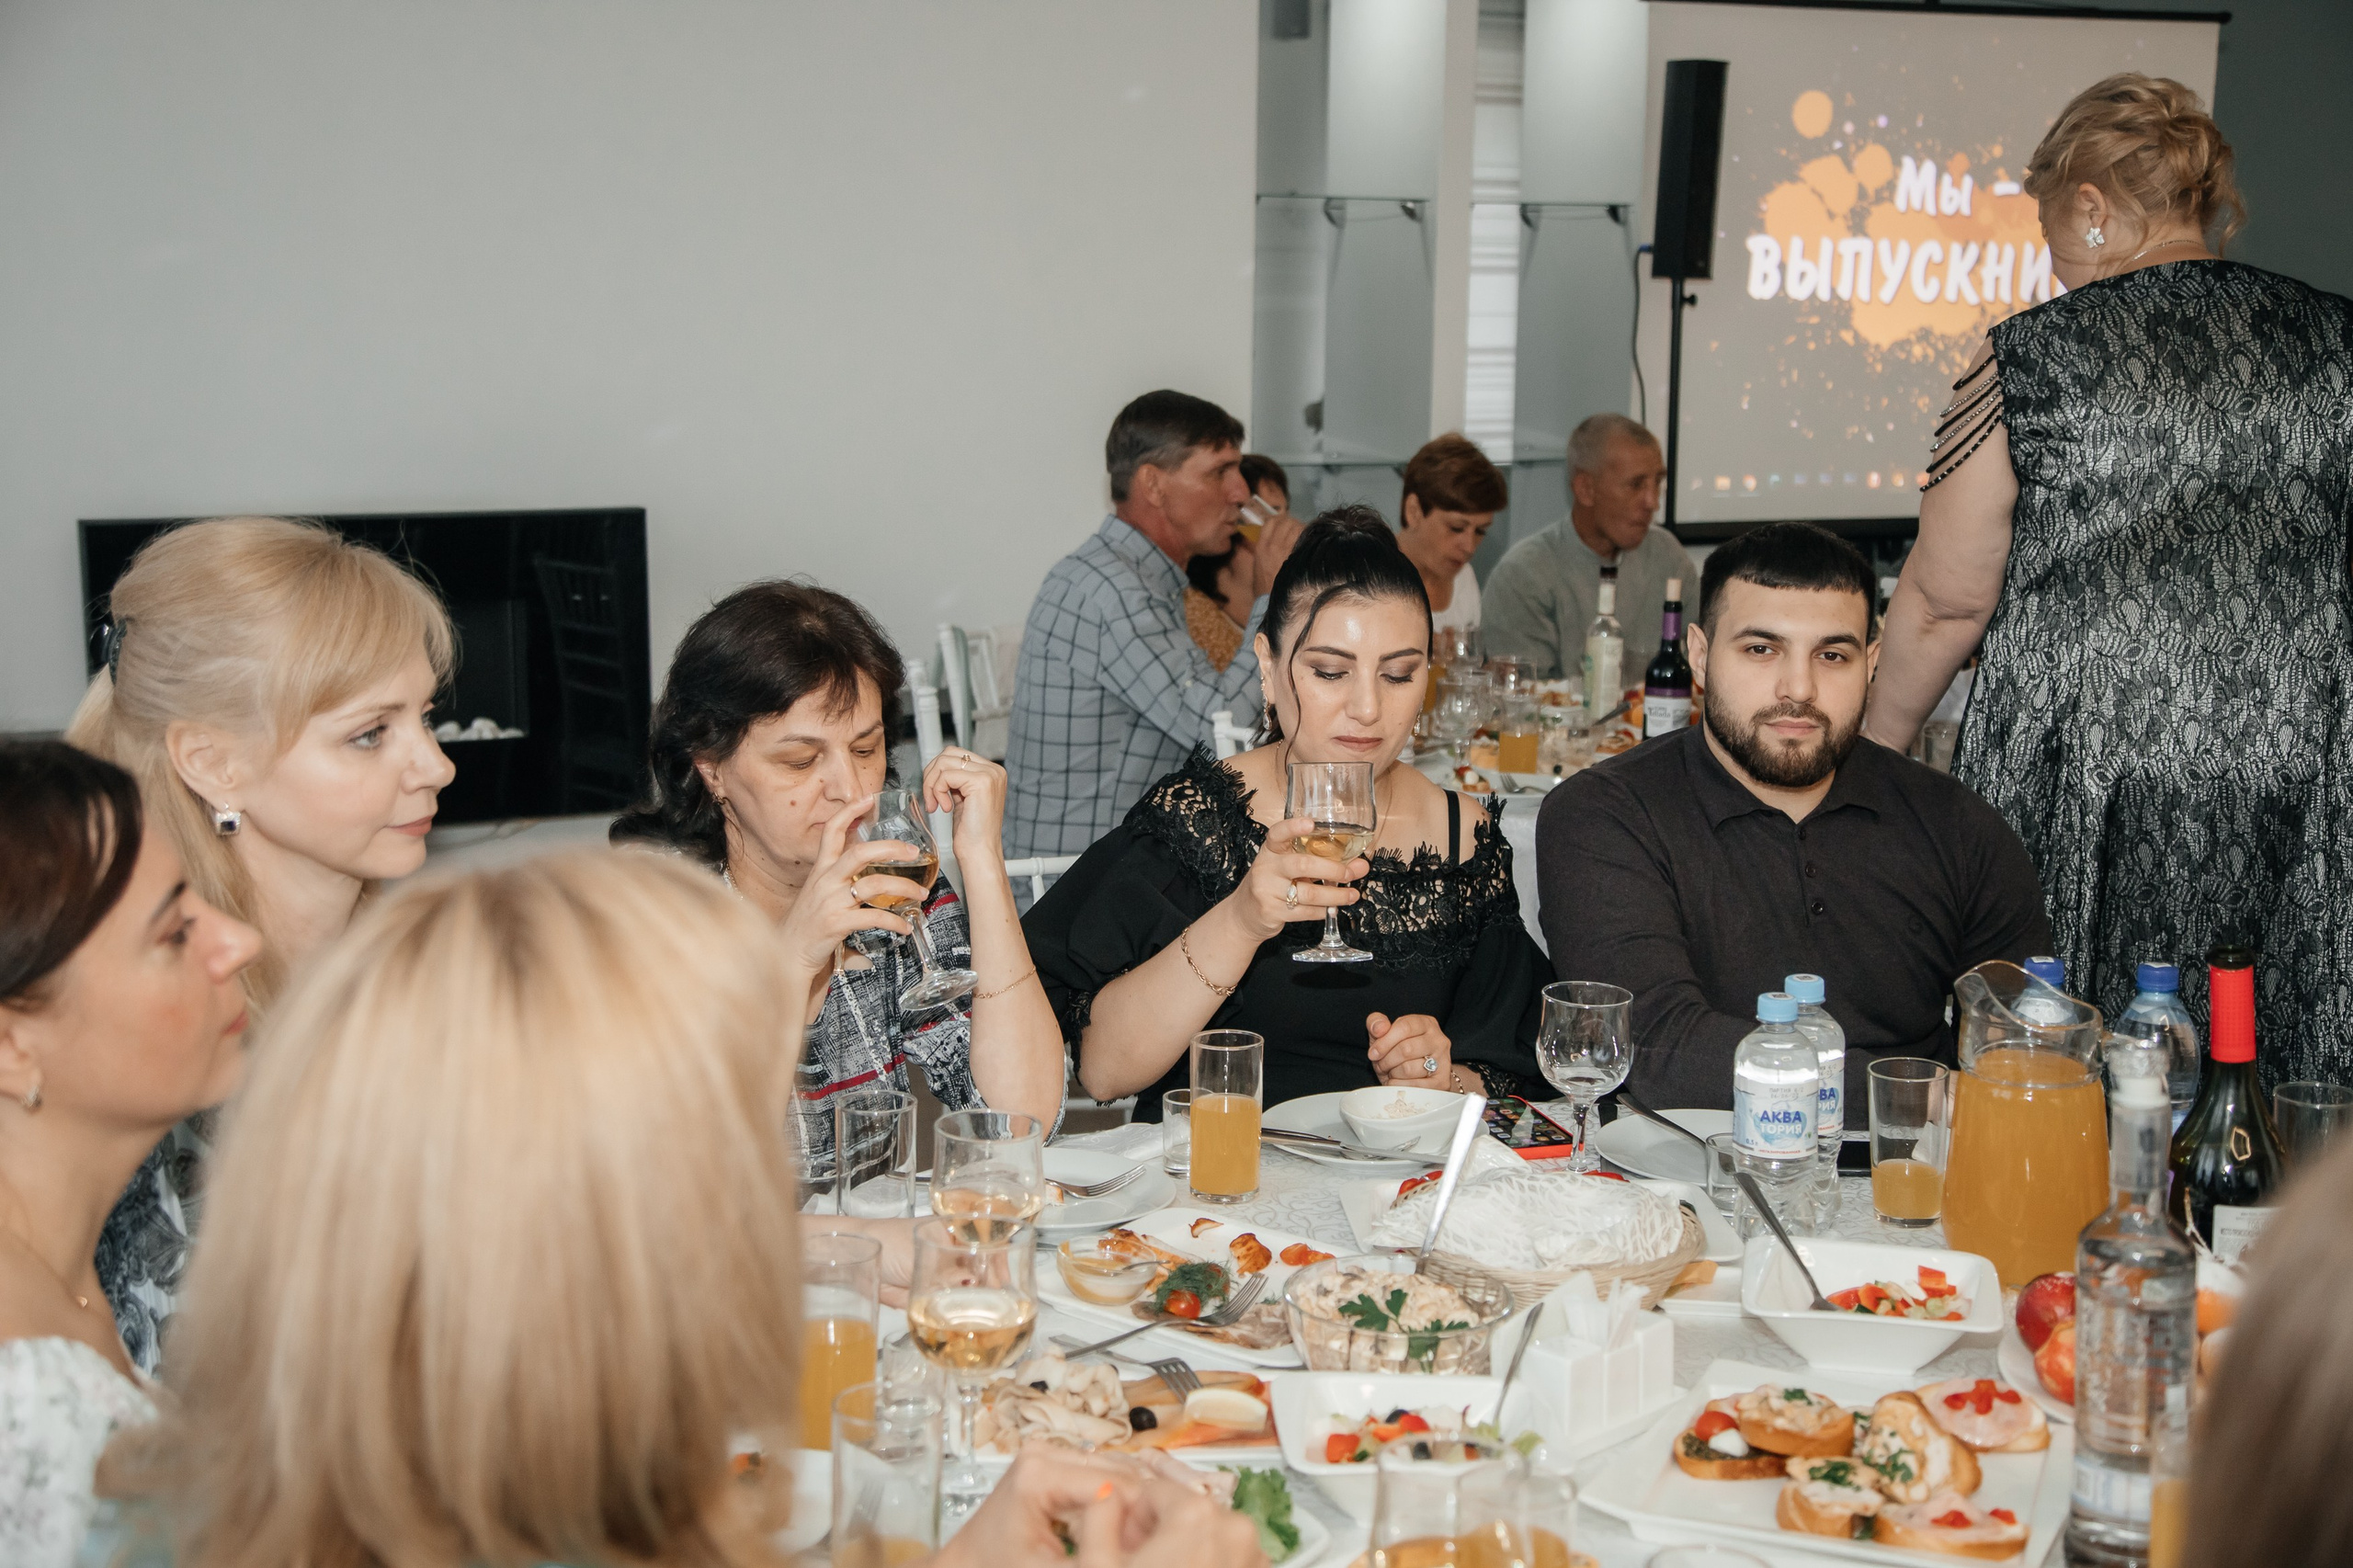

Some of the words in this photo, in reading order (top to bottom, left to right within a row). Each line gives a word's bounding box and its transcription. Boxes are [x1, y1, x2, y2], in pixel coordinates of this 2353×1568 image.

[1894, 154, 1974, 217] Мы
[1745, 233, 2068, 305] ВЫПУСКНИ
[1760, 1110, 1802, 1123] АКВА
[1760, 1124, 1802, 1135] ТОРИЯ
